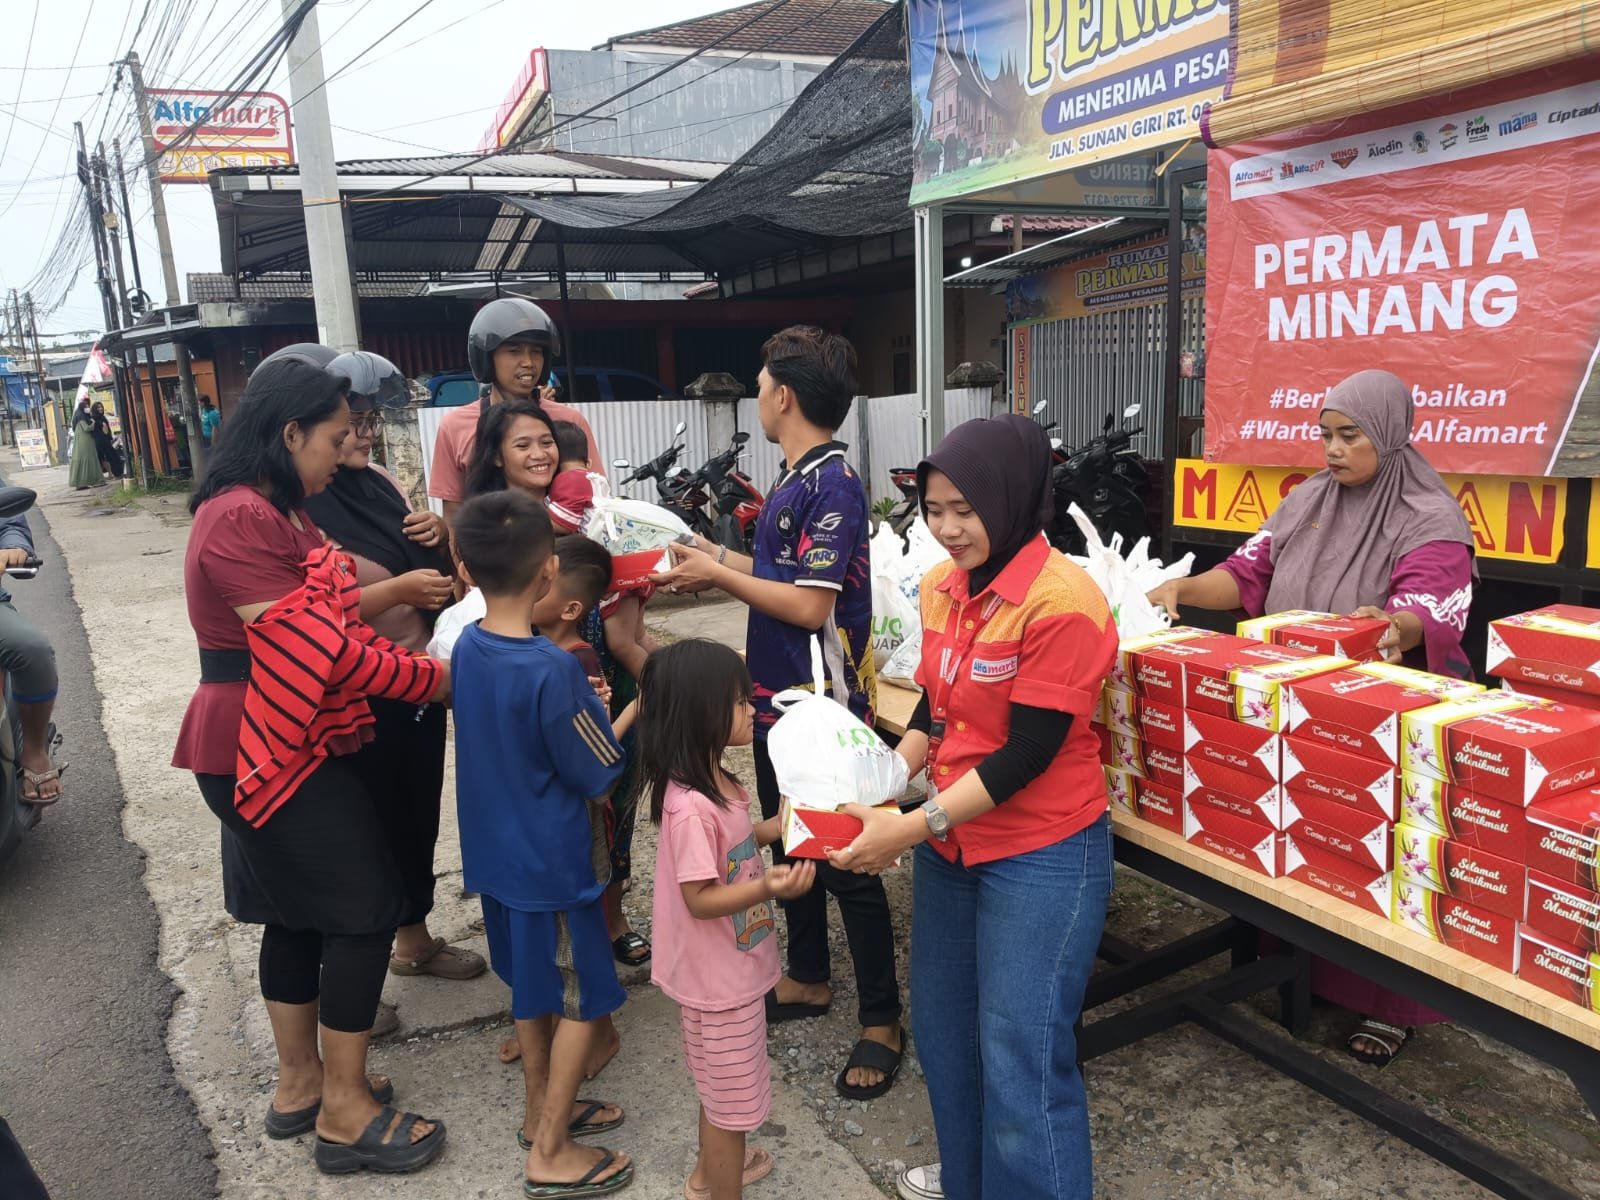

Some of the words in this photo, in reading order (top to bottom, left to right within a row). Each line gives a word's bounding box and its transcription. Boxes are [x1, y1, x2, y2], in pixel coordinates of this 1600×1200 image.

[154, 99, 279, 124] Alfamart
[1058, 71, 1168, 124] MENERIMA
[1547, 101, 1600, 124] Ciptad
[1049, 140, 1075, 160] JLN.
[1078, 124, 1127, 152] SUNAN
[1131, 114, 1163, 138] GIRI
[1166, 107, 1188, 129] RT.
[1466, 122, 1490, 137] Fresh
[1235, 167, 1274, 182] Alfamart
[1330, 147, 1360, 160] WINGS
[1368, 139, 1404, 159] Aladin
[1254, 207, 1540, 290] PERMATA
[1076, 259, 1188, 297] PERMAT
[1268, 274, 1519, 342] MINANG
[1017, 333, 1026, 416] SELAM
[973, 660, 1016, 674] Alfamart
[1454, 751, 1510, 778] Menikmati
[1462, 741, 1504, 763] Selamat
[1452, 807, 1509, 834] Menikmati
[1460, 797, 1502, 820] Selamat
[1449, 867, 1508, 896] Menikmati
[1457, 858, 1500, 881] Selamat
[1443, 914, 1499, 945] Menikmati
[1451, 905, 1492, 931] Selamat
[1534, 953, 1596, 989] Menikmati
